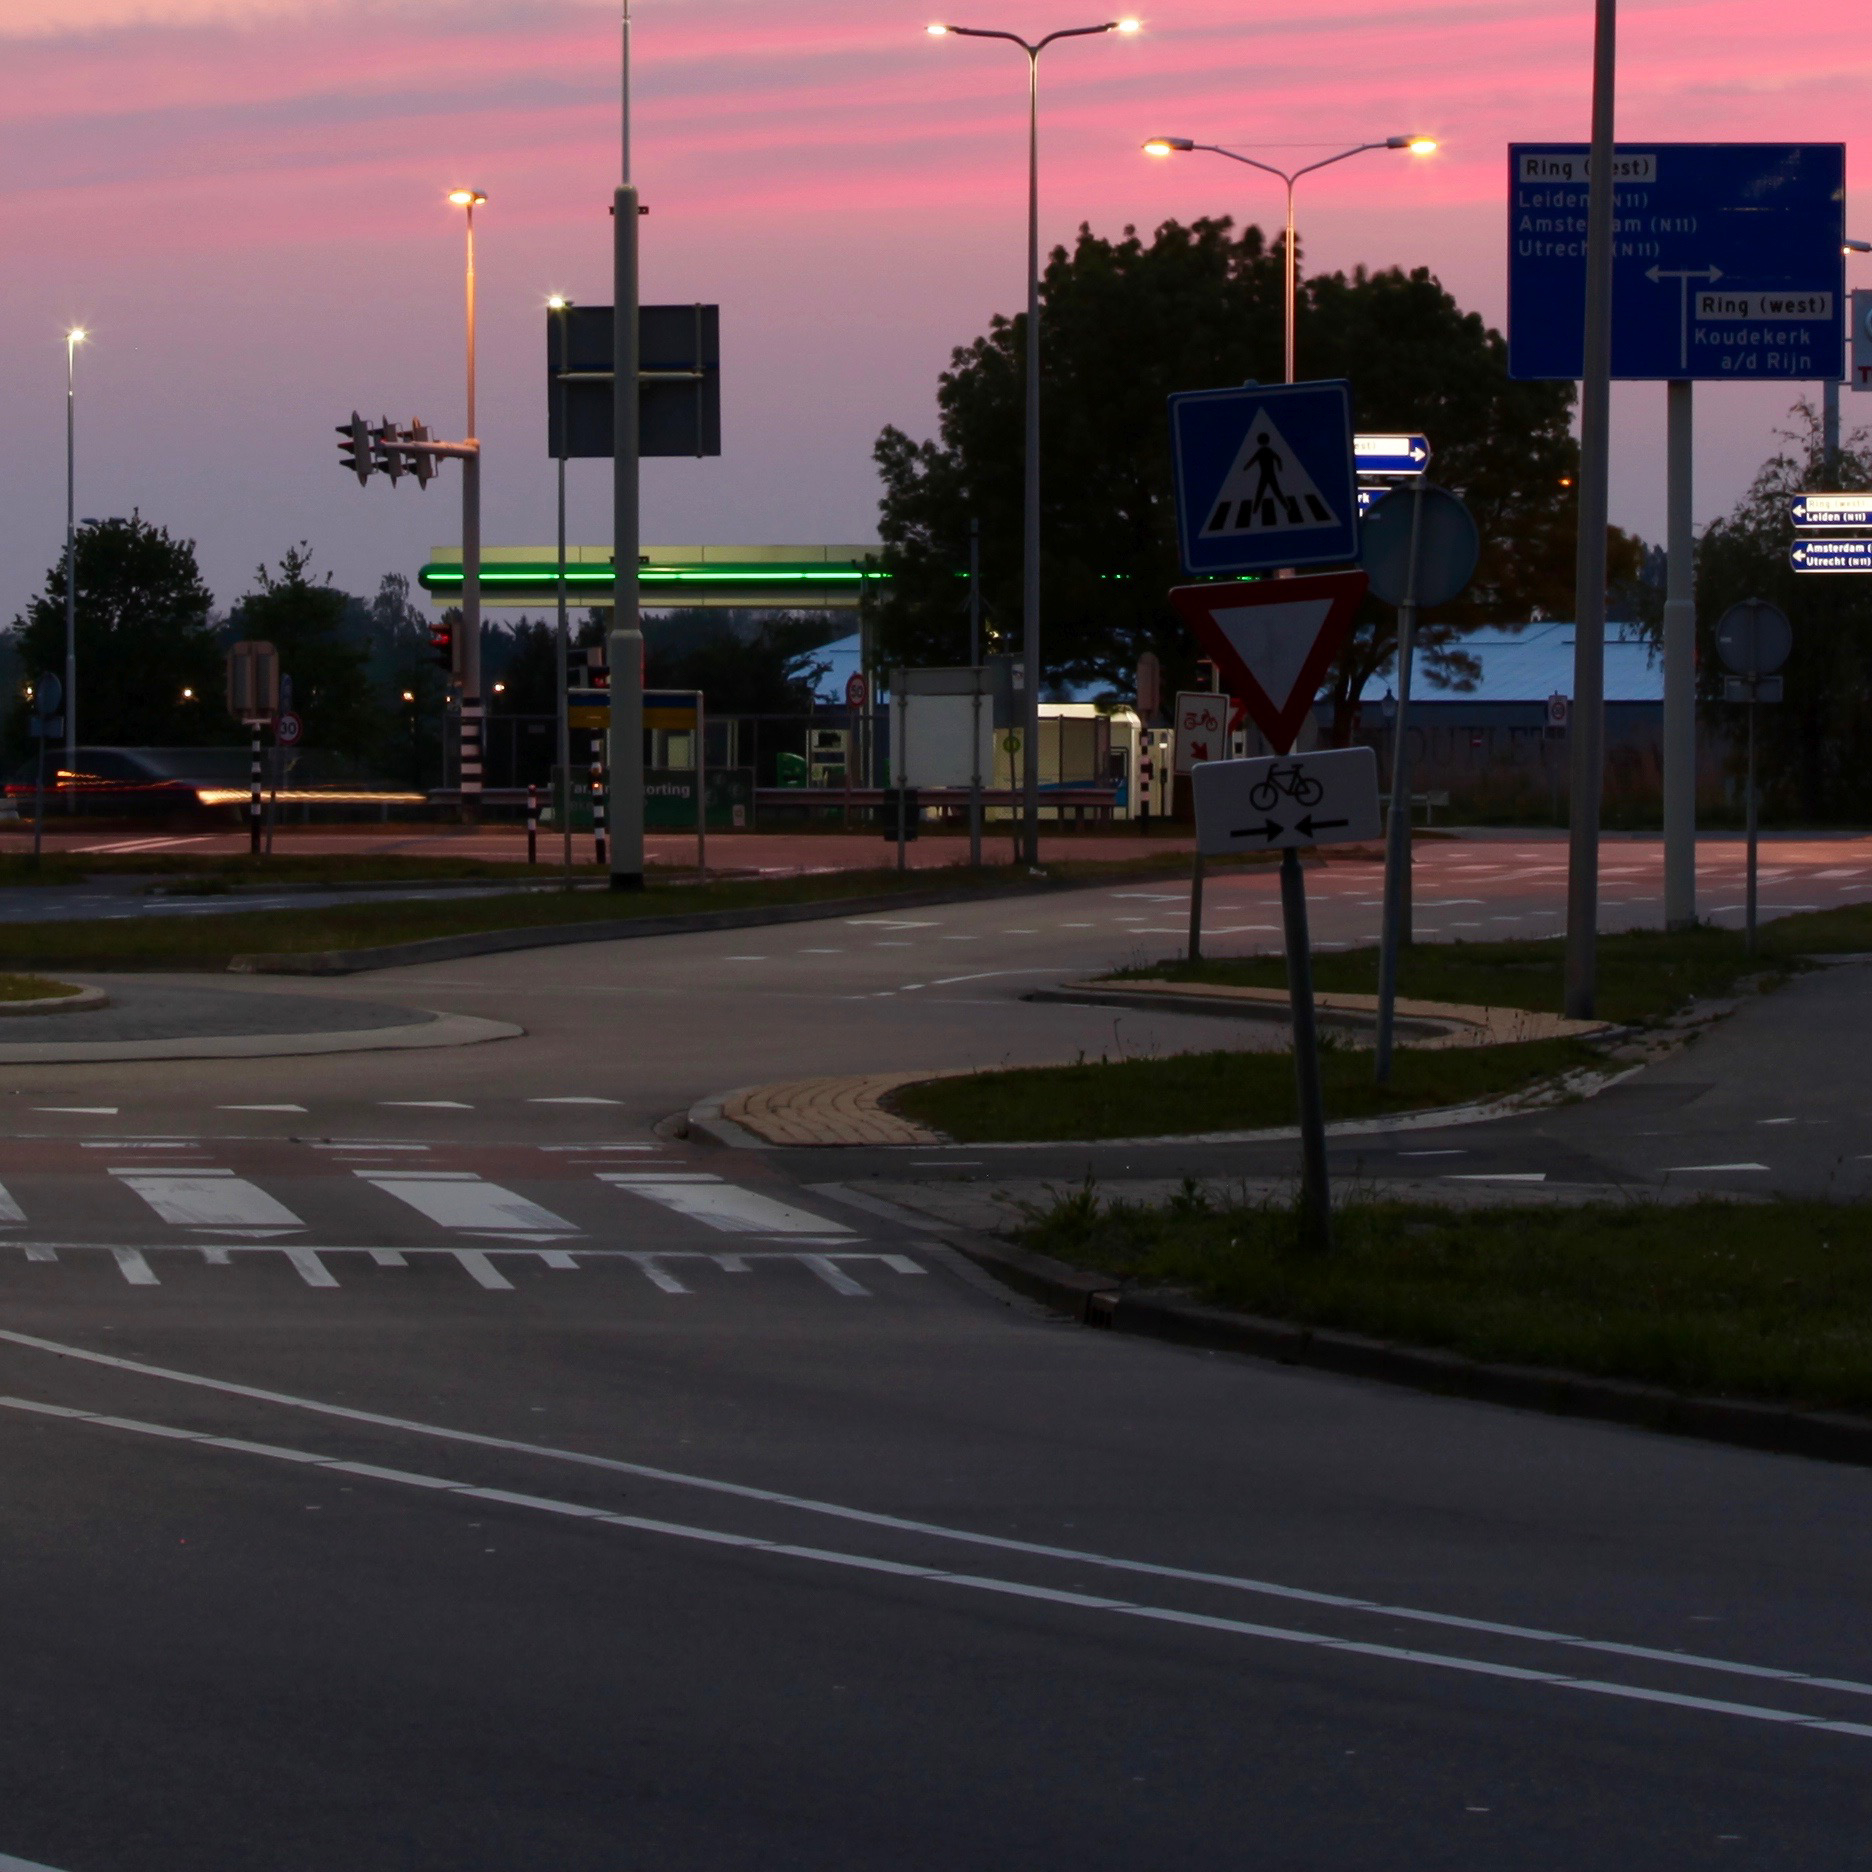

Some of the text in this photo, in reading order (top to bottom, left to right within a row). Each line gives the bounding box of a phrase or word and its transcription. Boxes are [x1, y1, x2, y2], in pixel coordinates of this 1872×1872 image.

[1526, 159, 1649, 181] Ring (est)
[1519, 190, 1648, 209] Leiden N11)
[1519, 215, 1698, 234] Amsteam (N11)
[1519, 239, 1588, 257] Utrech
[1702, 296, 1826, 318] Ring (west)
[1694, 328, 1811, 346] Koudekerk
[1721, 351, 1812, 374] a/d Rijn
[1806, 512, 1867, 522] Leiden (N11)
[1806, 543, 1865, 553] Amsterdam
[1806, 557, 1872, 566] Utrecht (N11)
[644, 782, 690, 799] orting
